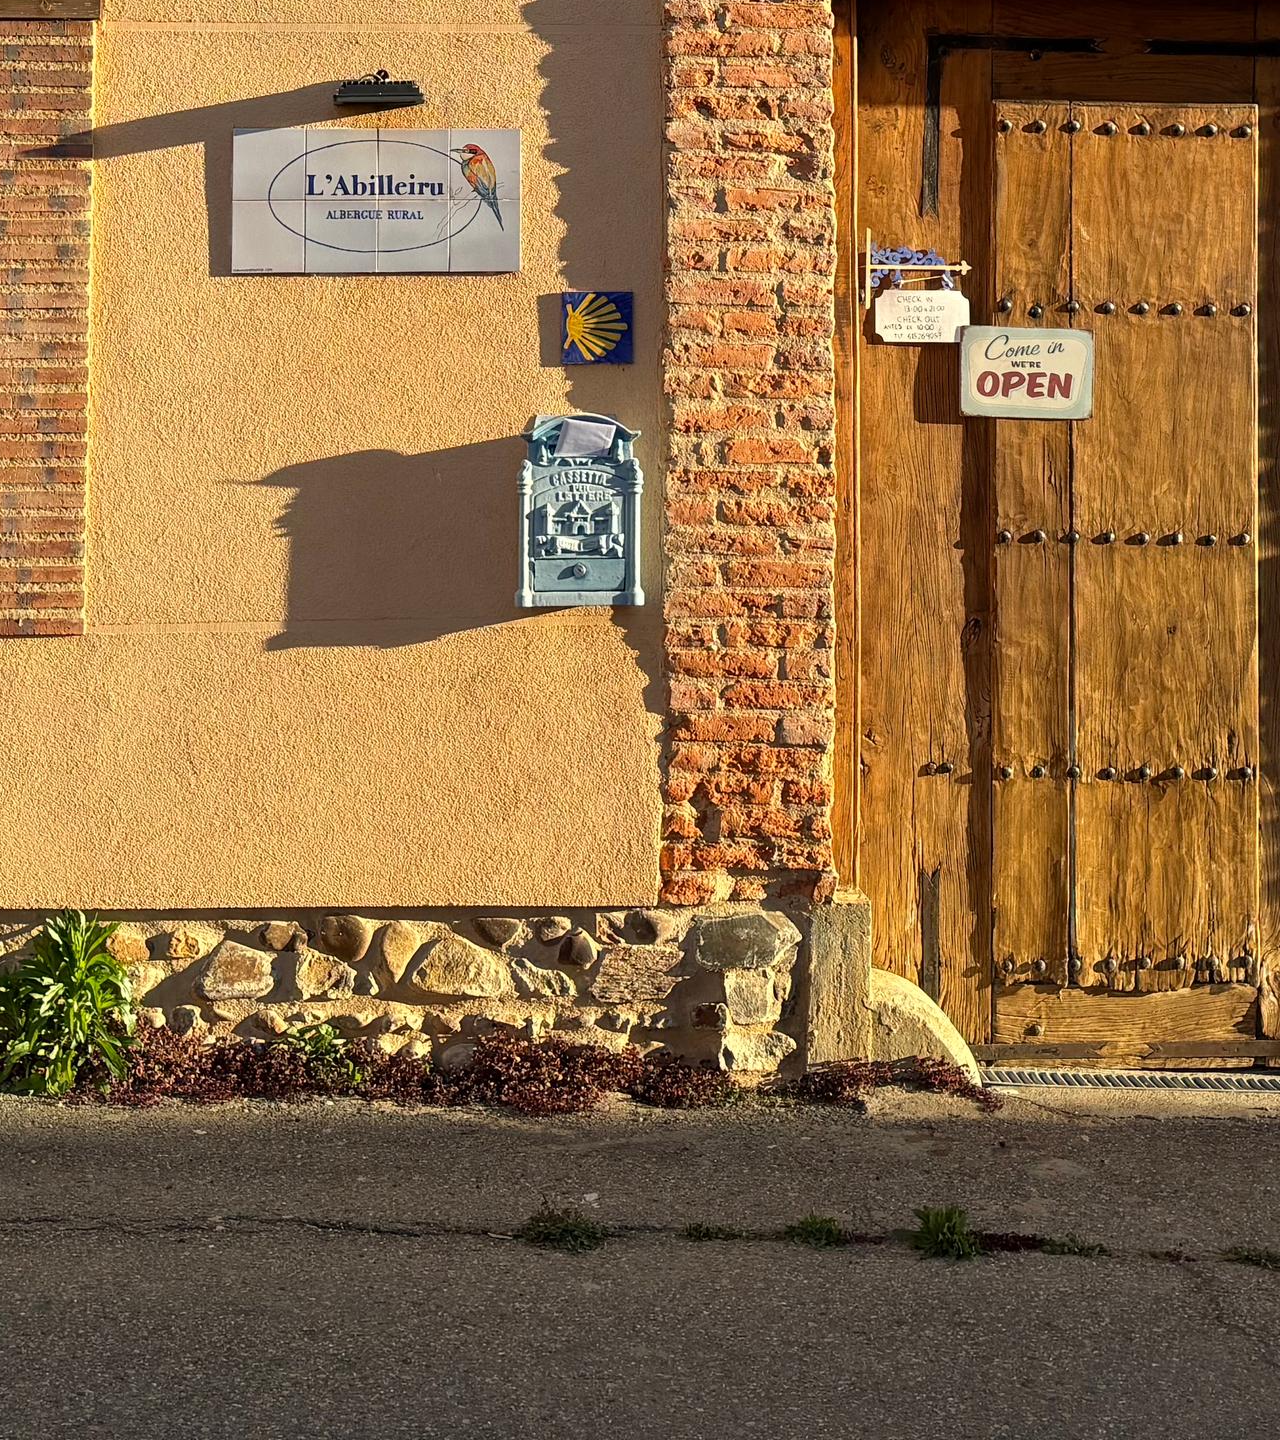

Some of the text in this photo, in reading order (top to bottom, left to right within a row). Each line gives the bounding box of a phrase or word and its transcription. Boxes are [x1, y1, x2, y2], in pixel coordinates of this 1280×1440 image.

[305, 173, 445, 196] L'Abilleiru
[325, 209, 424, 220] ALBERGUE RURAL
[897, 295, 922, 303] CHECK
[924, 315, 941, 323] OUT
[984, 334, 1065, 360] Come in
[1011, 361, 1041, 369] WE'RE
[976, 370, 1073, 399] OPEN
